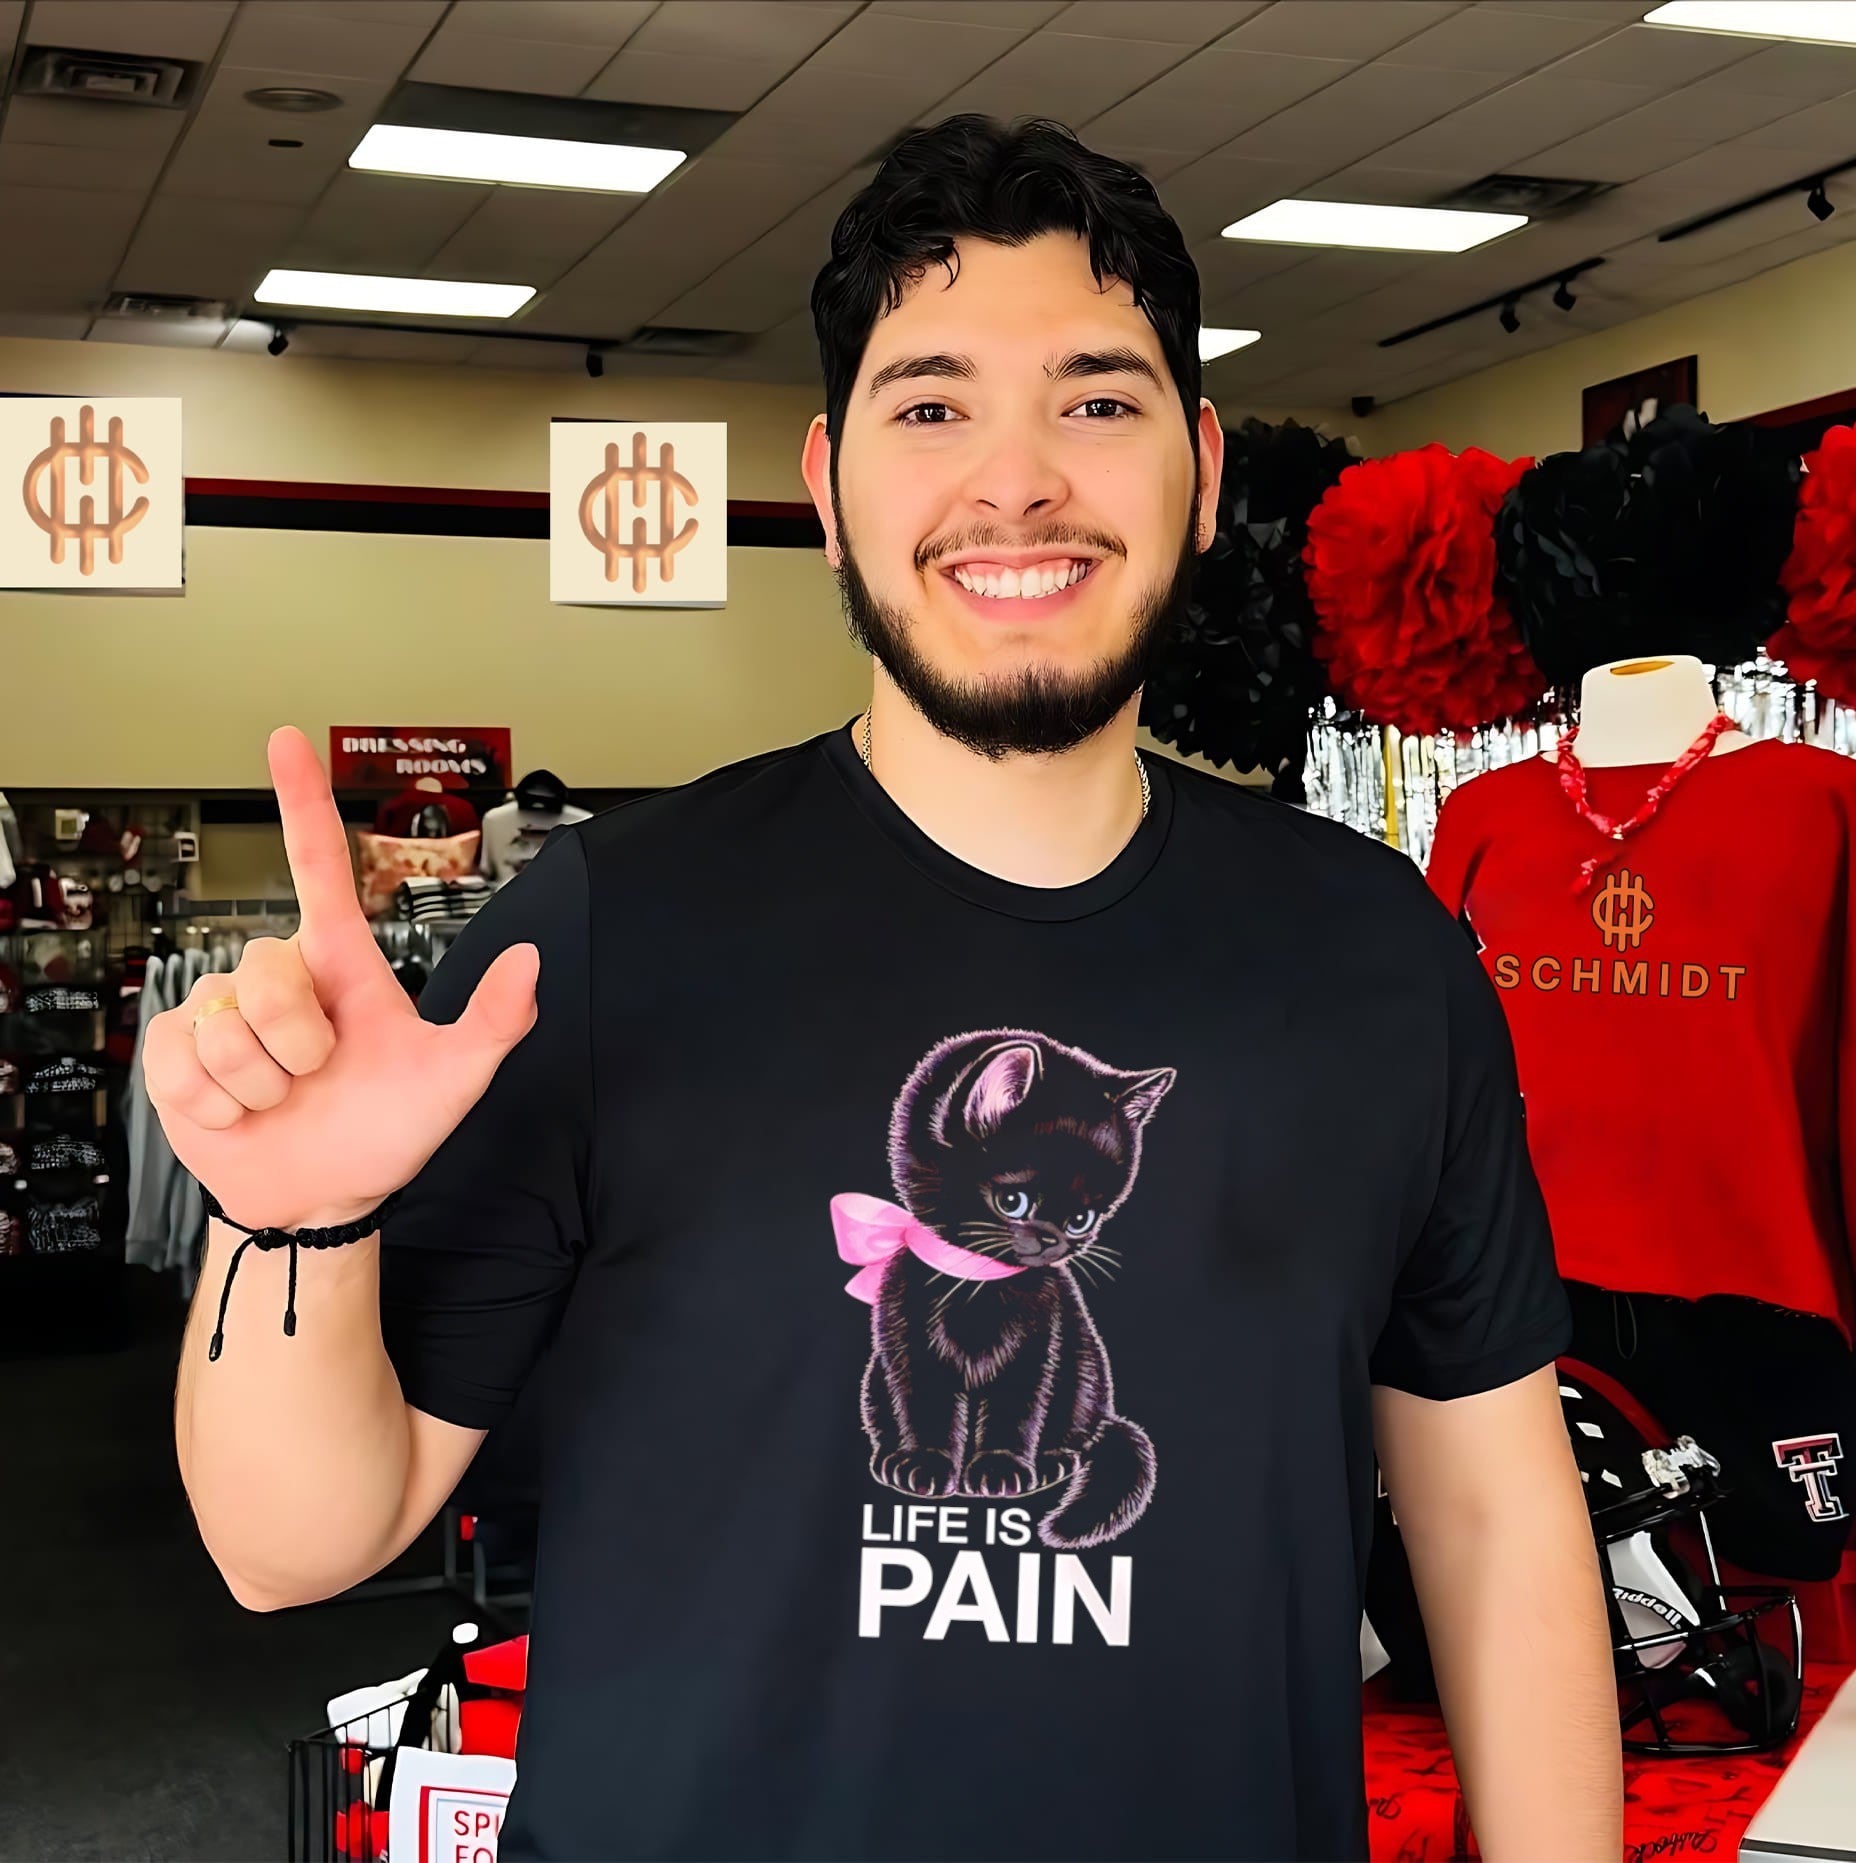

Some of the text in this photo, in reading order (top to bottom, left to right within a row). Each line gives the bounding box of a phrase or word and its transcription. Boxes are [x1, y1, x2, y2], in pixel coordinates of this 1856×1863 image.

[342, 737, 467, 754] DRESSING
[396, 758, 487, 775] ROOMS
[1494, 954, 1747, 1001] SCHMIDT
[862, 1503, 1032, 1547] LIFE IS
[858, 1546, 1133, 1647] PAIN
